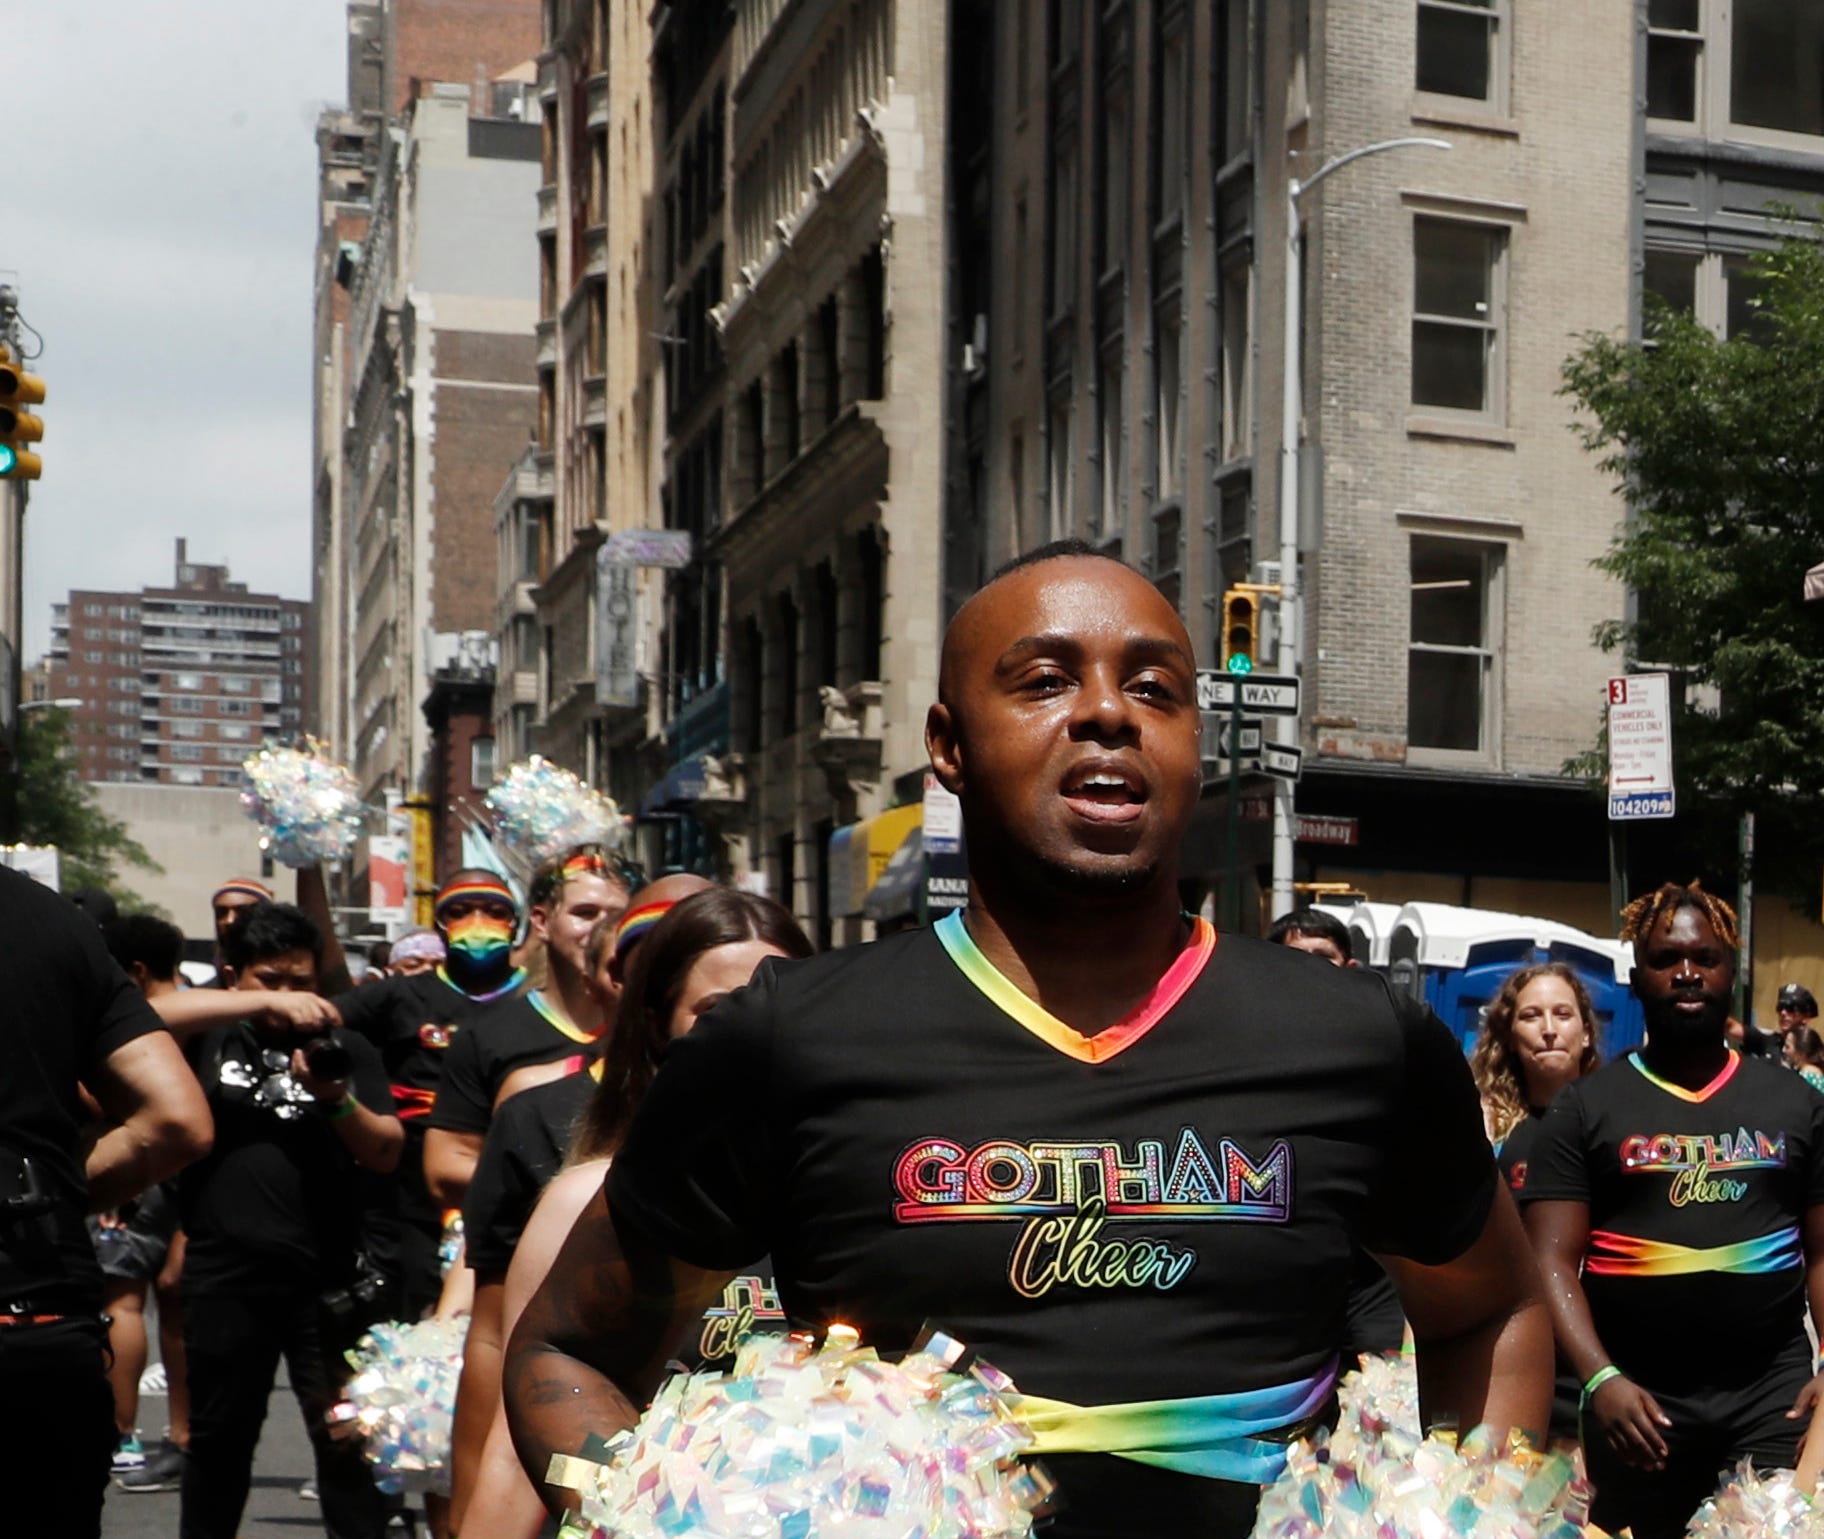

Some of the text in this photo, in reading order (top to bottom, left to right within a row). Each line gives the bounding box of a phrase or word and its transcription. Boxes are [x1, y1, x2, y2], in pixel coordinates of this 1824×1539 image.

[1199, 684, 1281, 702] NE WAY
[1612, 680, 1624, 703] 3
[895, 1127, 1293, 1206] GOTHAM
[1619, 1126, 1787, 1166] GOTHAM
[1669, 1161, 1748, 1208] Cheer
[1009, 1195, 1194, 1298] Cheer
